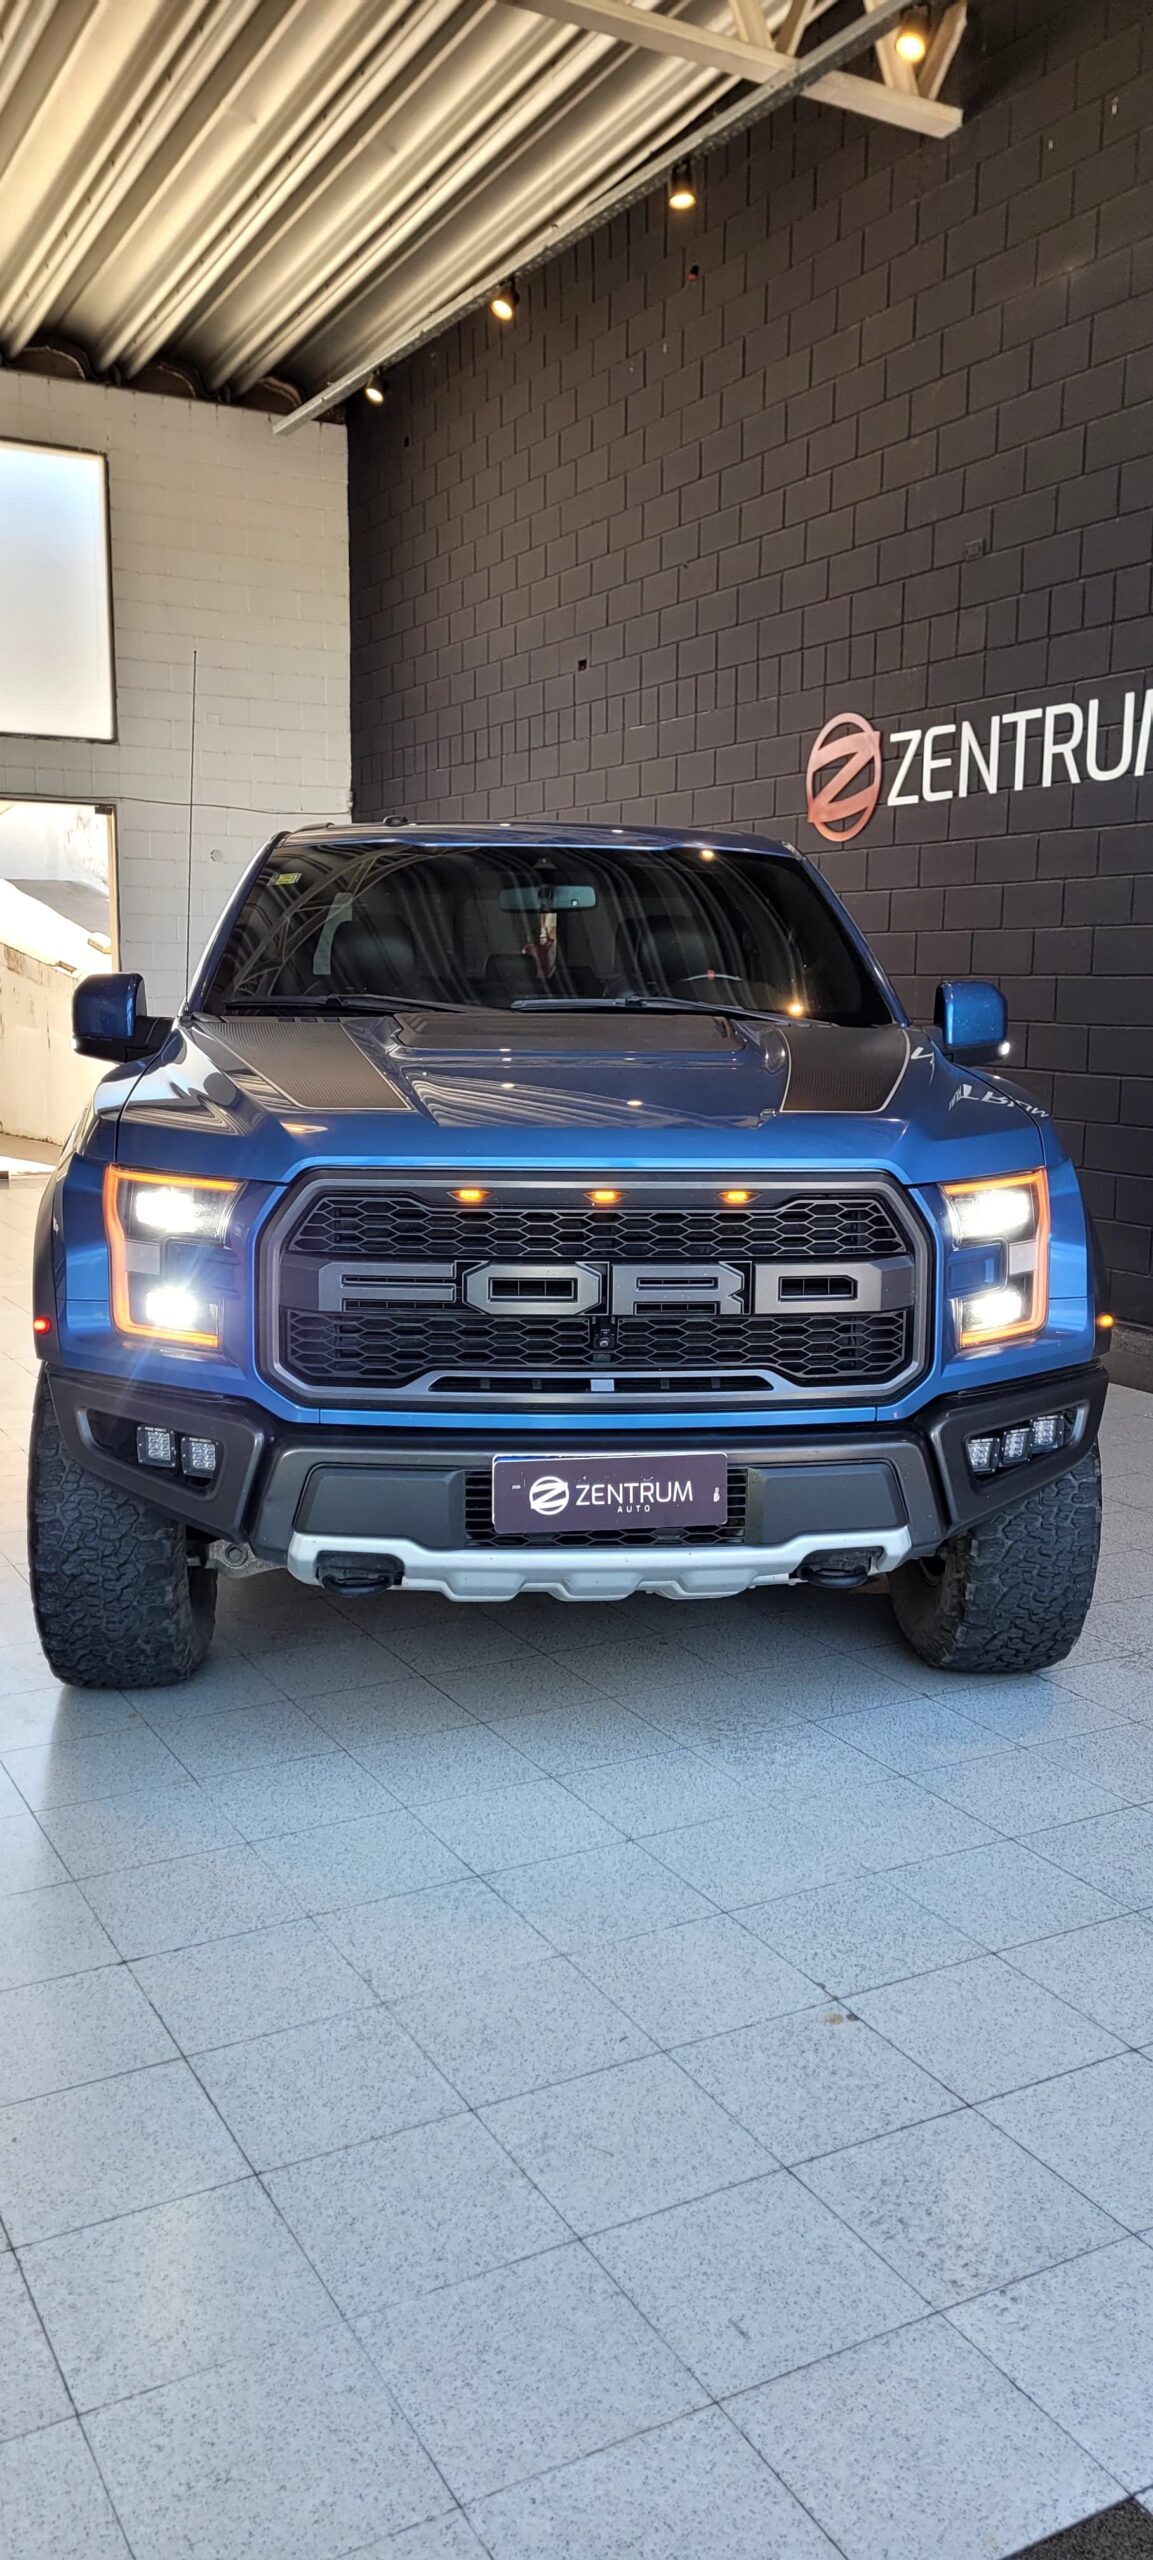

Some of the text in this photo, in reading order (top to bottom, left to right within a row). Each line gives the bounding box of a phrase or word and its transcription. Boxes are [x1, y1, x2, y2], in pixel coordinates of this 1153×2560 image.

[319, 1261, 882, 1316] FORD
[575, 1480, 694, 1506] ZENTRUM
[616, 1504, 651, 1514] AUTO
